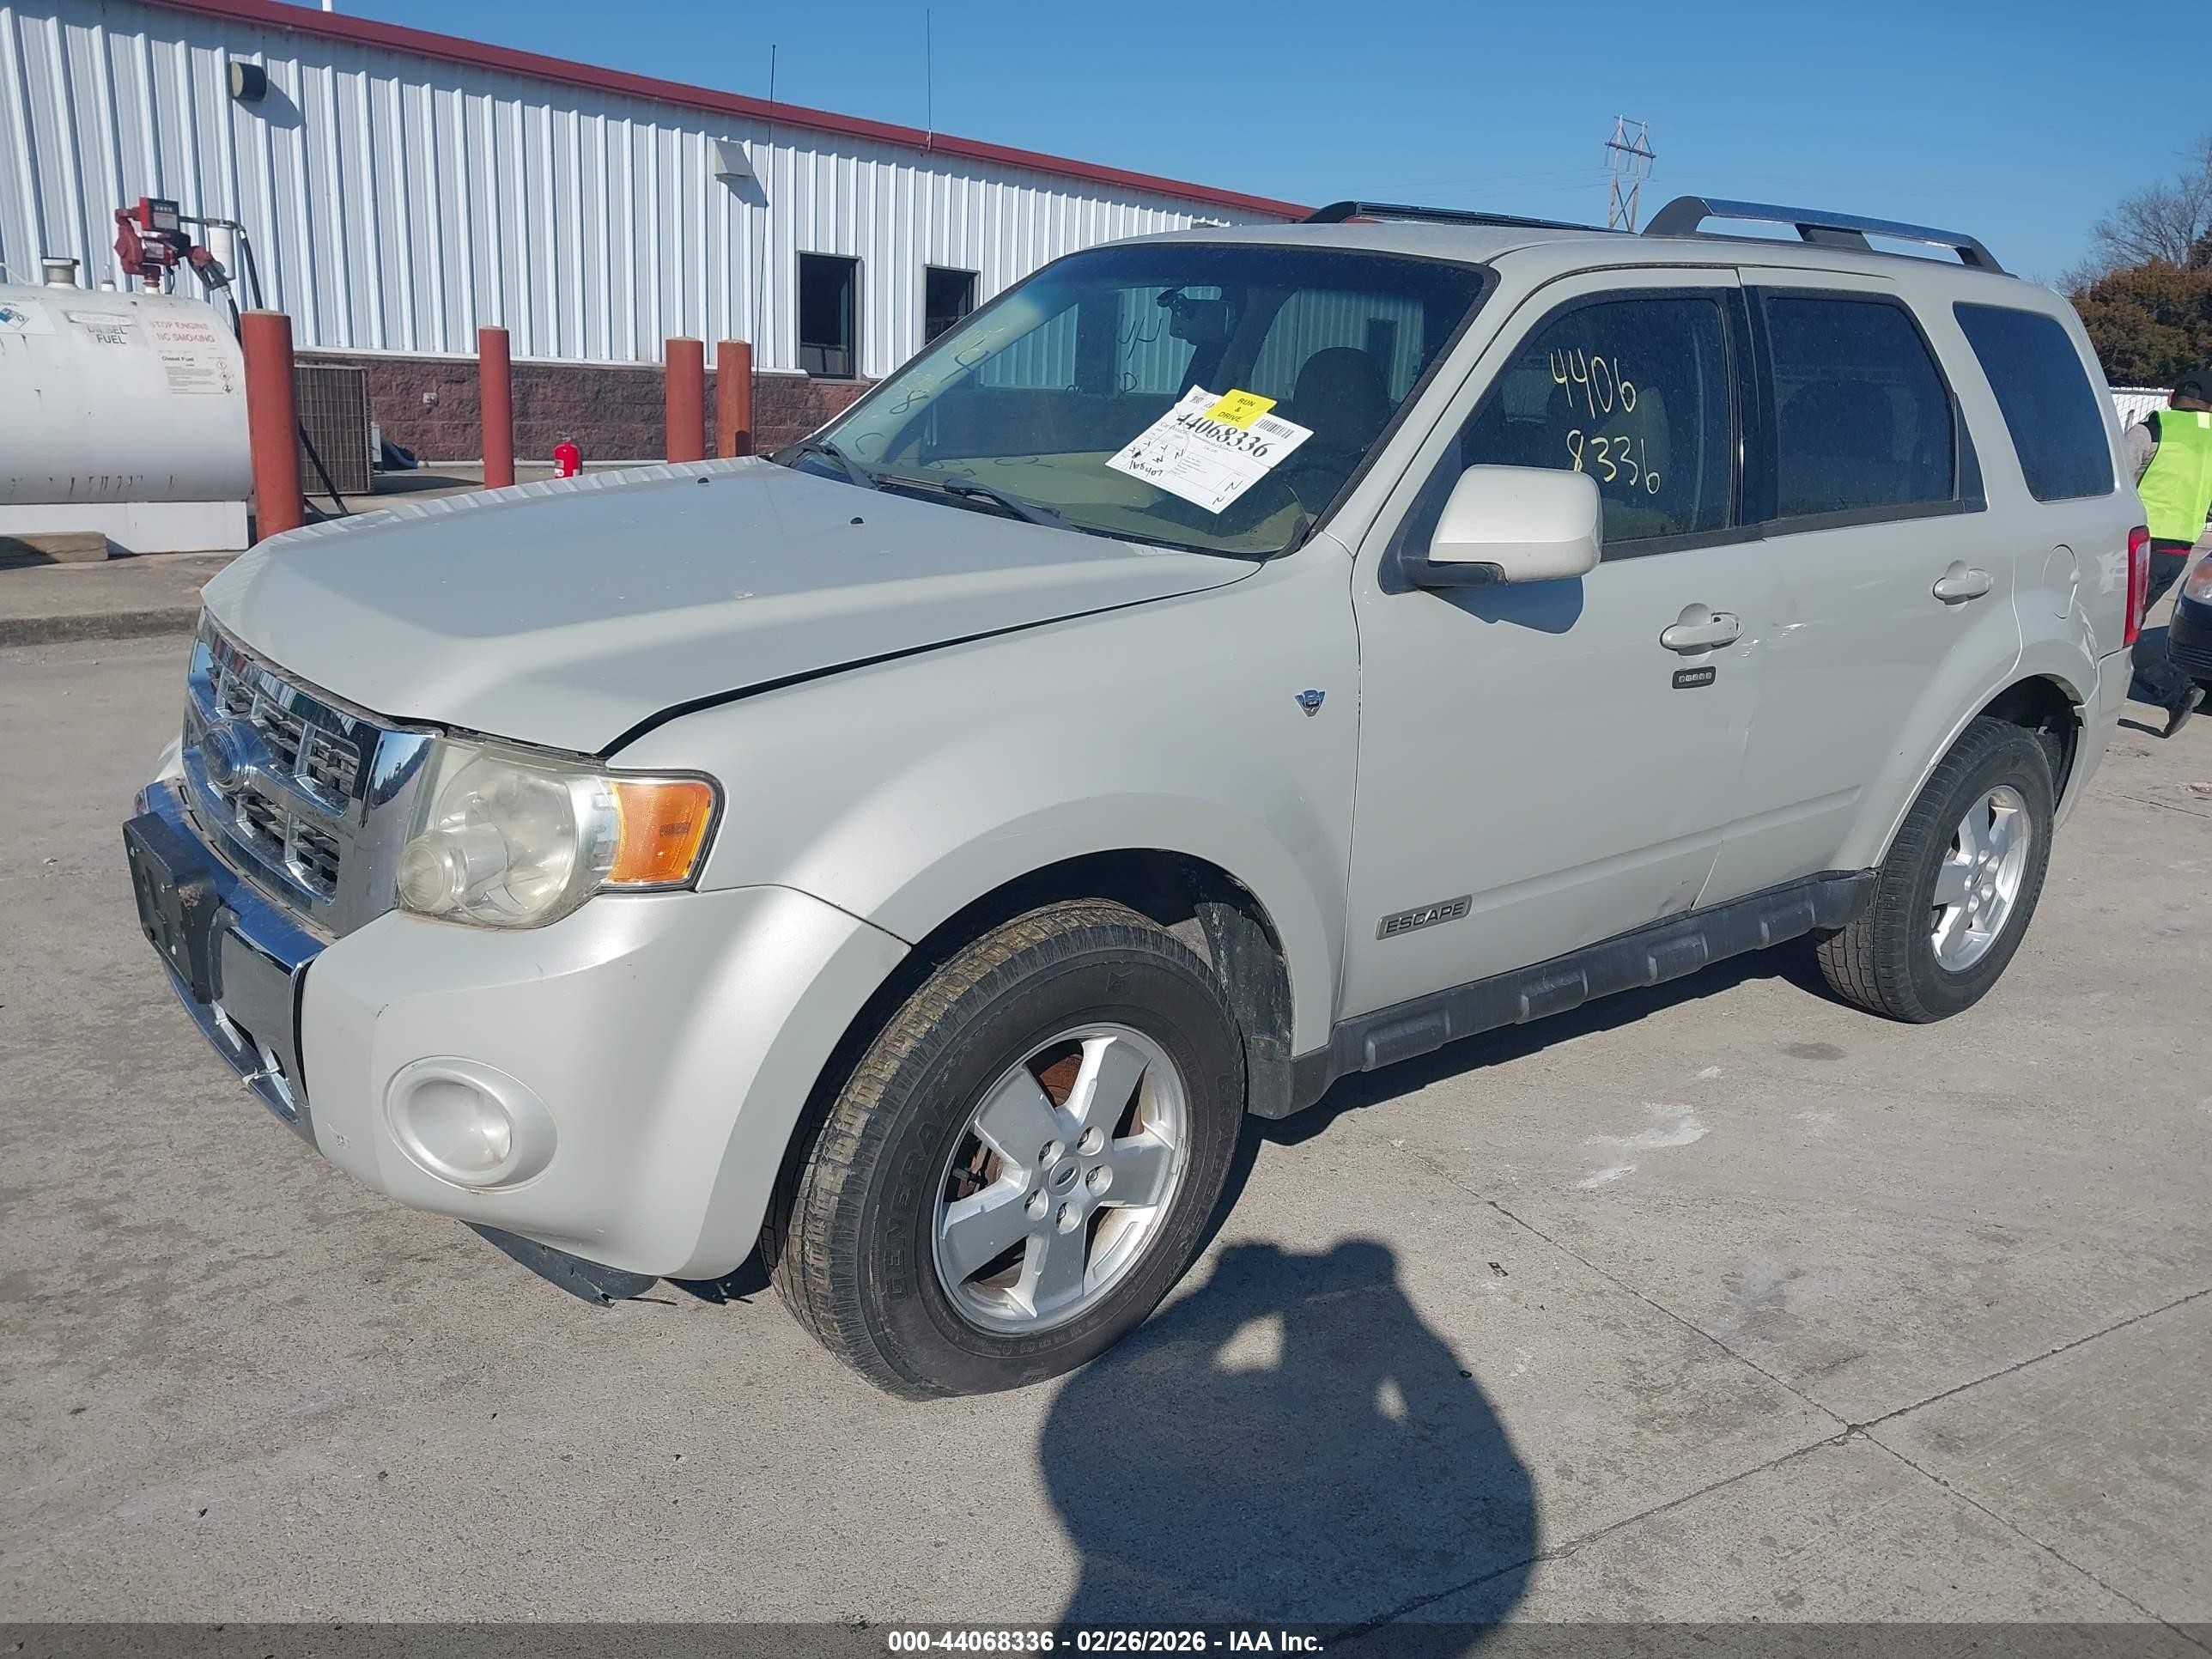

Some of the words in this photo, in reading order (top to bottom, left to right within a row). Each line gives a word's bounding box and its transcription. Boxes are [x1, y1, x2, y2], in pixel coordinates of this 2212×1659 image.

[96, 334, 127, 344] FUEL
[173, 333, 216, 343] SMOKING
[1551, 348, 1637, 420] 4406
[1218, 411, 1243, 422] DRIVE
[1237, 398, 1255, 407] RUN
[1176, 412, 1277, 458] 44068336
[1567, 429, 1660, 494] 8336
[1385, 902, 1464, 933] ESCAPE
[881, 1094, 958, 1302] GENERAL
